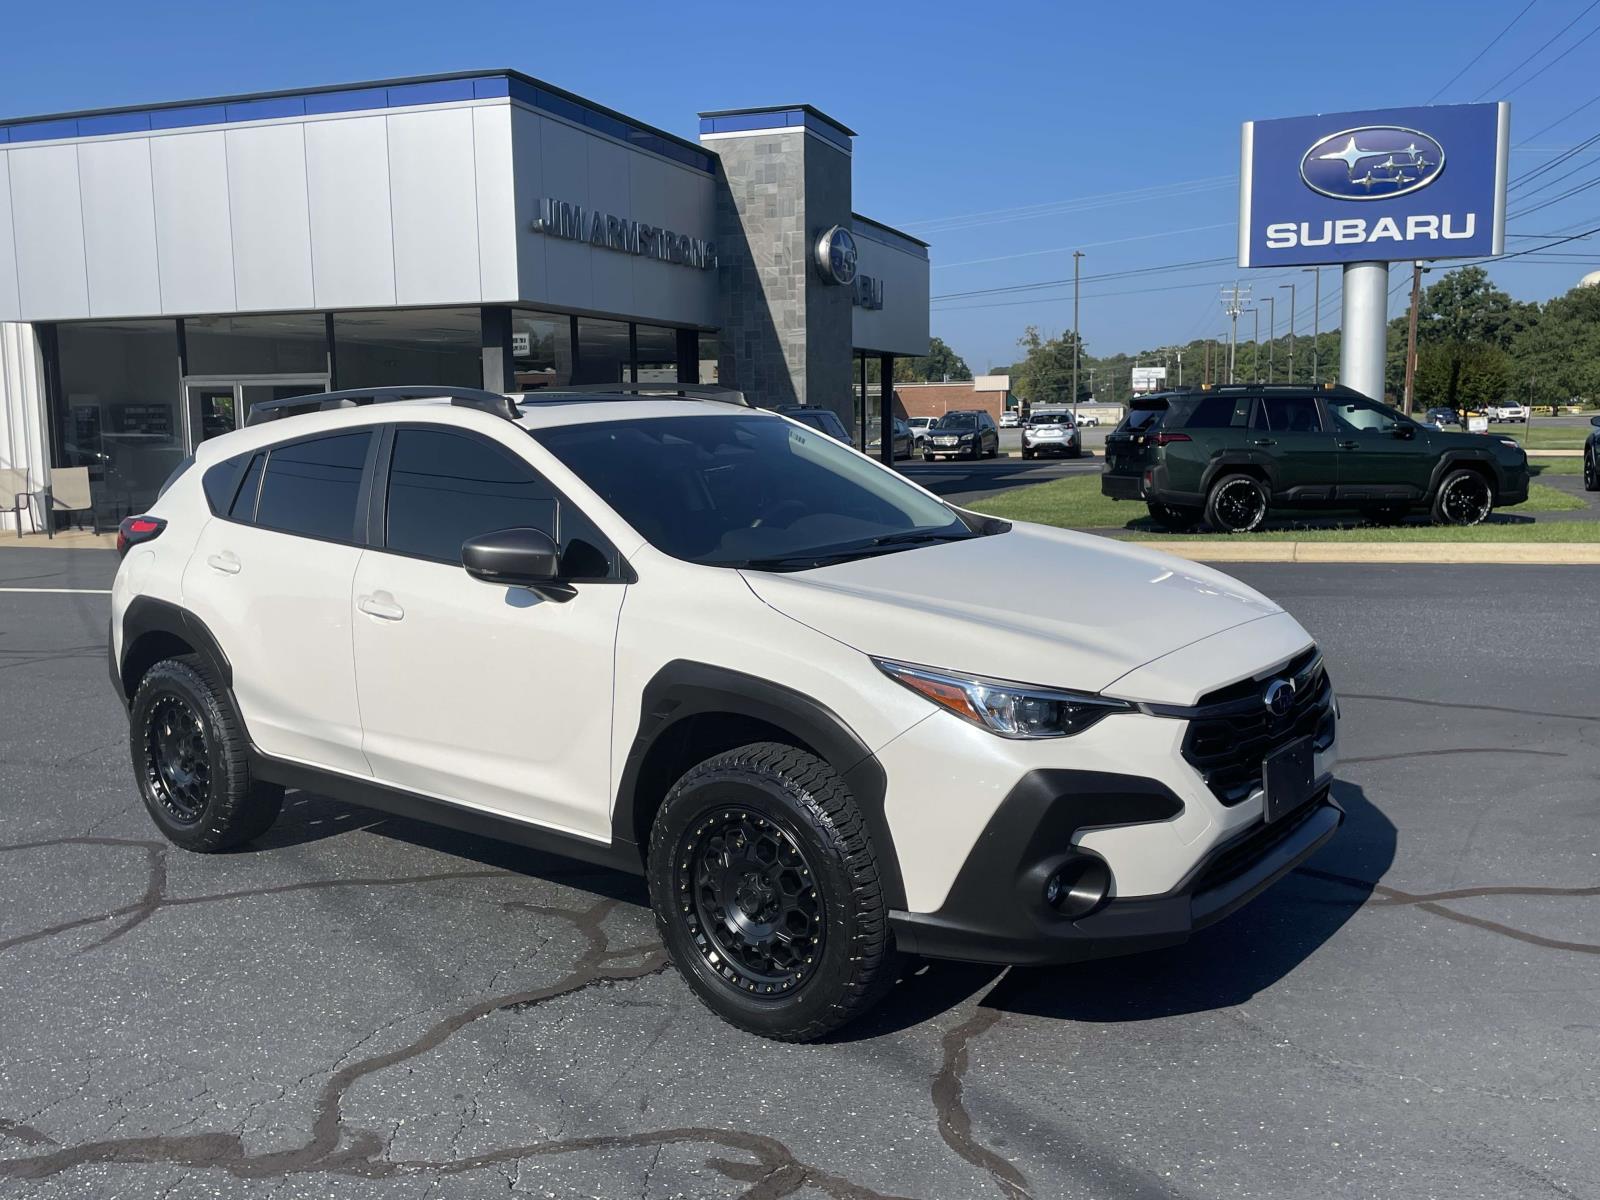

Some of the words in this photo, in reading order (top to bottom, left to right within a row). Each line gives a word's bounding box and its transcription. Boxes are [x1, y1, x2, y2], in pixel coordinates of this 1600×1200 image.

[530, 198, 586, 243] JIM
[590, 210, 719, 271] ARMSTRONG
[1266, 213, 1476, 249] SUBARU
